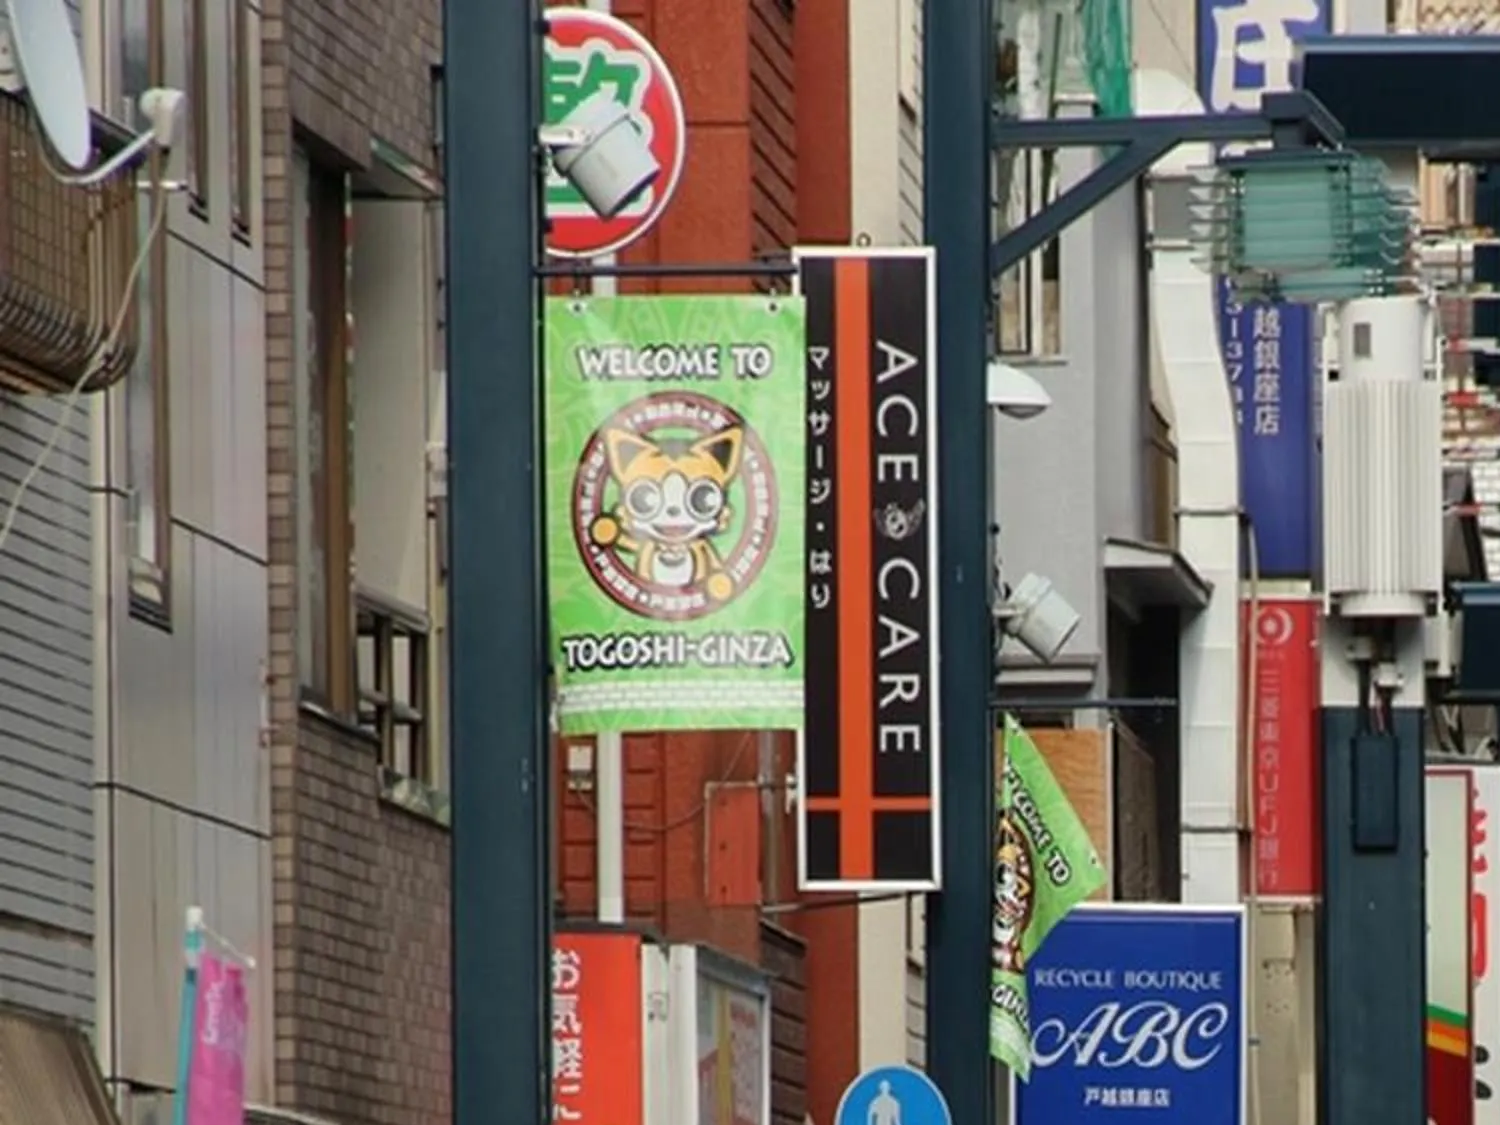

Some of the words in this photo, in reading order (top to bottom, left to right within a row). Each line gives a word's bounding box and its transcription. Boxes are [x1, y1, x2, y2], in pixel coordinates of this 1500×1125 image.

[577, 345, 722, 380] WELCOME
[732, 345, 773, 378] TO
[875, 340, 919, 482] ACE
[808, 345, 831, 608] マッサージ・はり
[562, 634, 793, 669] TOGOSHI-GINZA
[878, 557, 921, 753] CARE
[1035, 969, 1114, 989] RECYCLE
[1124, 970, 1223, 992] BOUTIQUE
[1031, 1000, 1229, 1071] ABC
